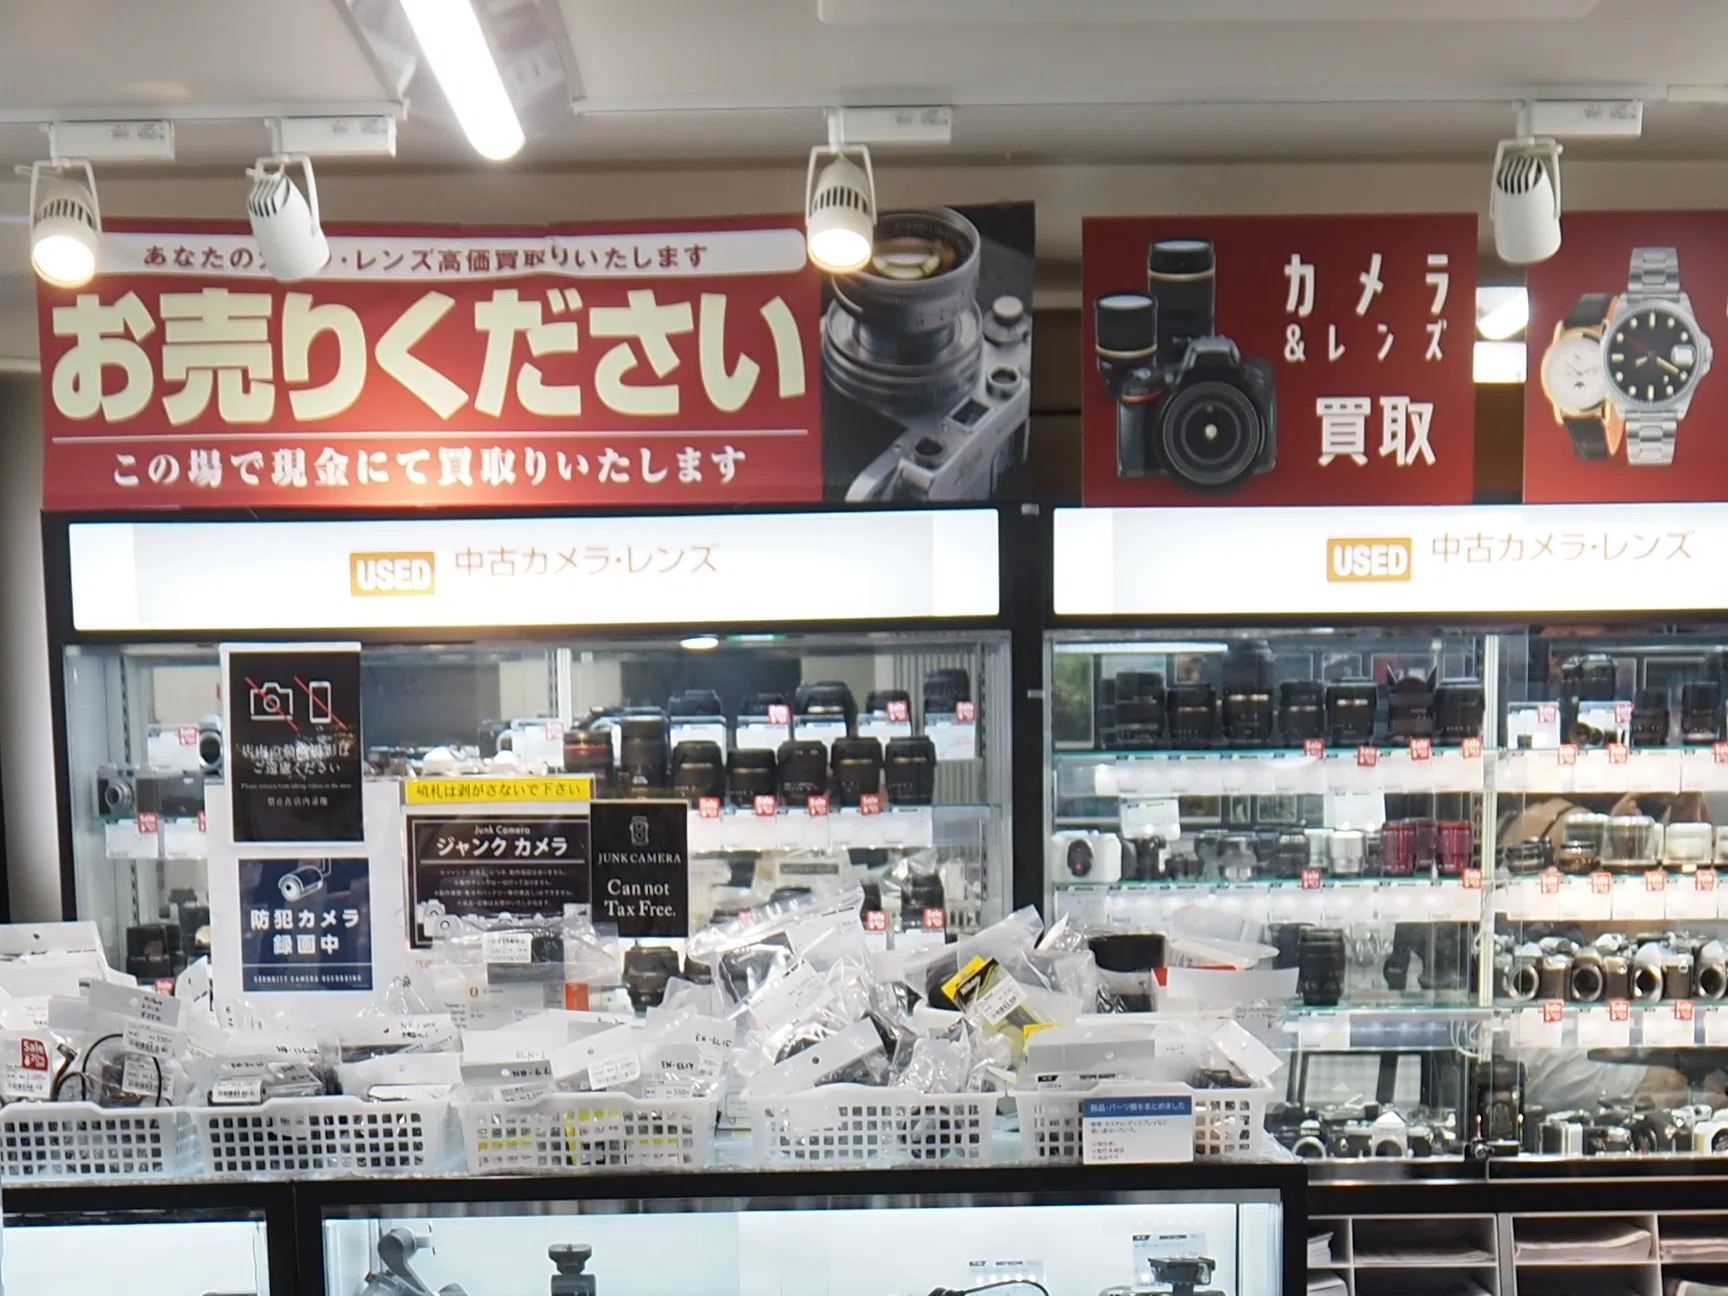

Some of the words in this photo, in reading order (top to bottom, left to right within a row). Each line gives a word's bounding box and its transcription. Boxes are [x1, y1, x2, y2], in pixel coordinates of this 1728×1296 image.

[144, 243, 709, 275] あなたの・レンズ高価買取りいたします
[1284, 252, 1450, 318] カメラ
[51, 287, 808, 428] お売りください
[1315, 394, 1437, 468] 買取
[112, 446, 749, 490] この場で現金にて買取りいたします
[453, 542, 720, 580] 中古カメラ・レンズ
[1332, 542, 1409, 578] USED
[1429, 528, 1697, 566] 中古カメラ・レンズ
[355, 559, 432, 594] USED
[436, 836, 507, 857] ジャンク
[514, 836, 569, 857] カメラ
[474, 825, 494, 836] Junk
[496, 825, 531, 835] Camera
[598, 852, 628, 865] JUNK
[630, 852, 682, 864] CAMERA
[607, 878, 641, 896] Can
[644, 883, 670, 896] not
[250, 908, 359, 930] 防犯カメラ
[604, 899, 635, 917] Tax
[638, 899, 677, 918] Free.
[273, 933, 340, 955] 録画中
[22, 1041, 44, 1054] Sale
